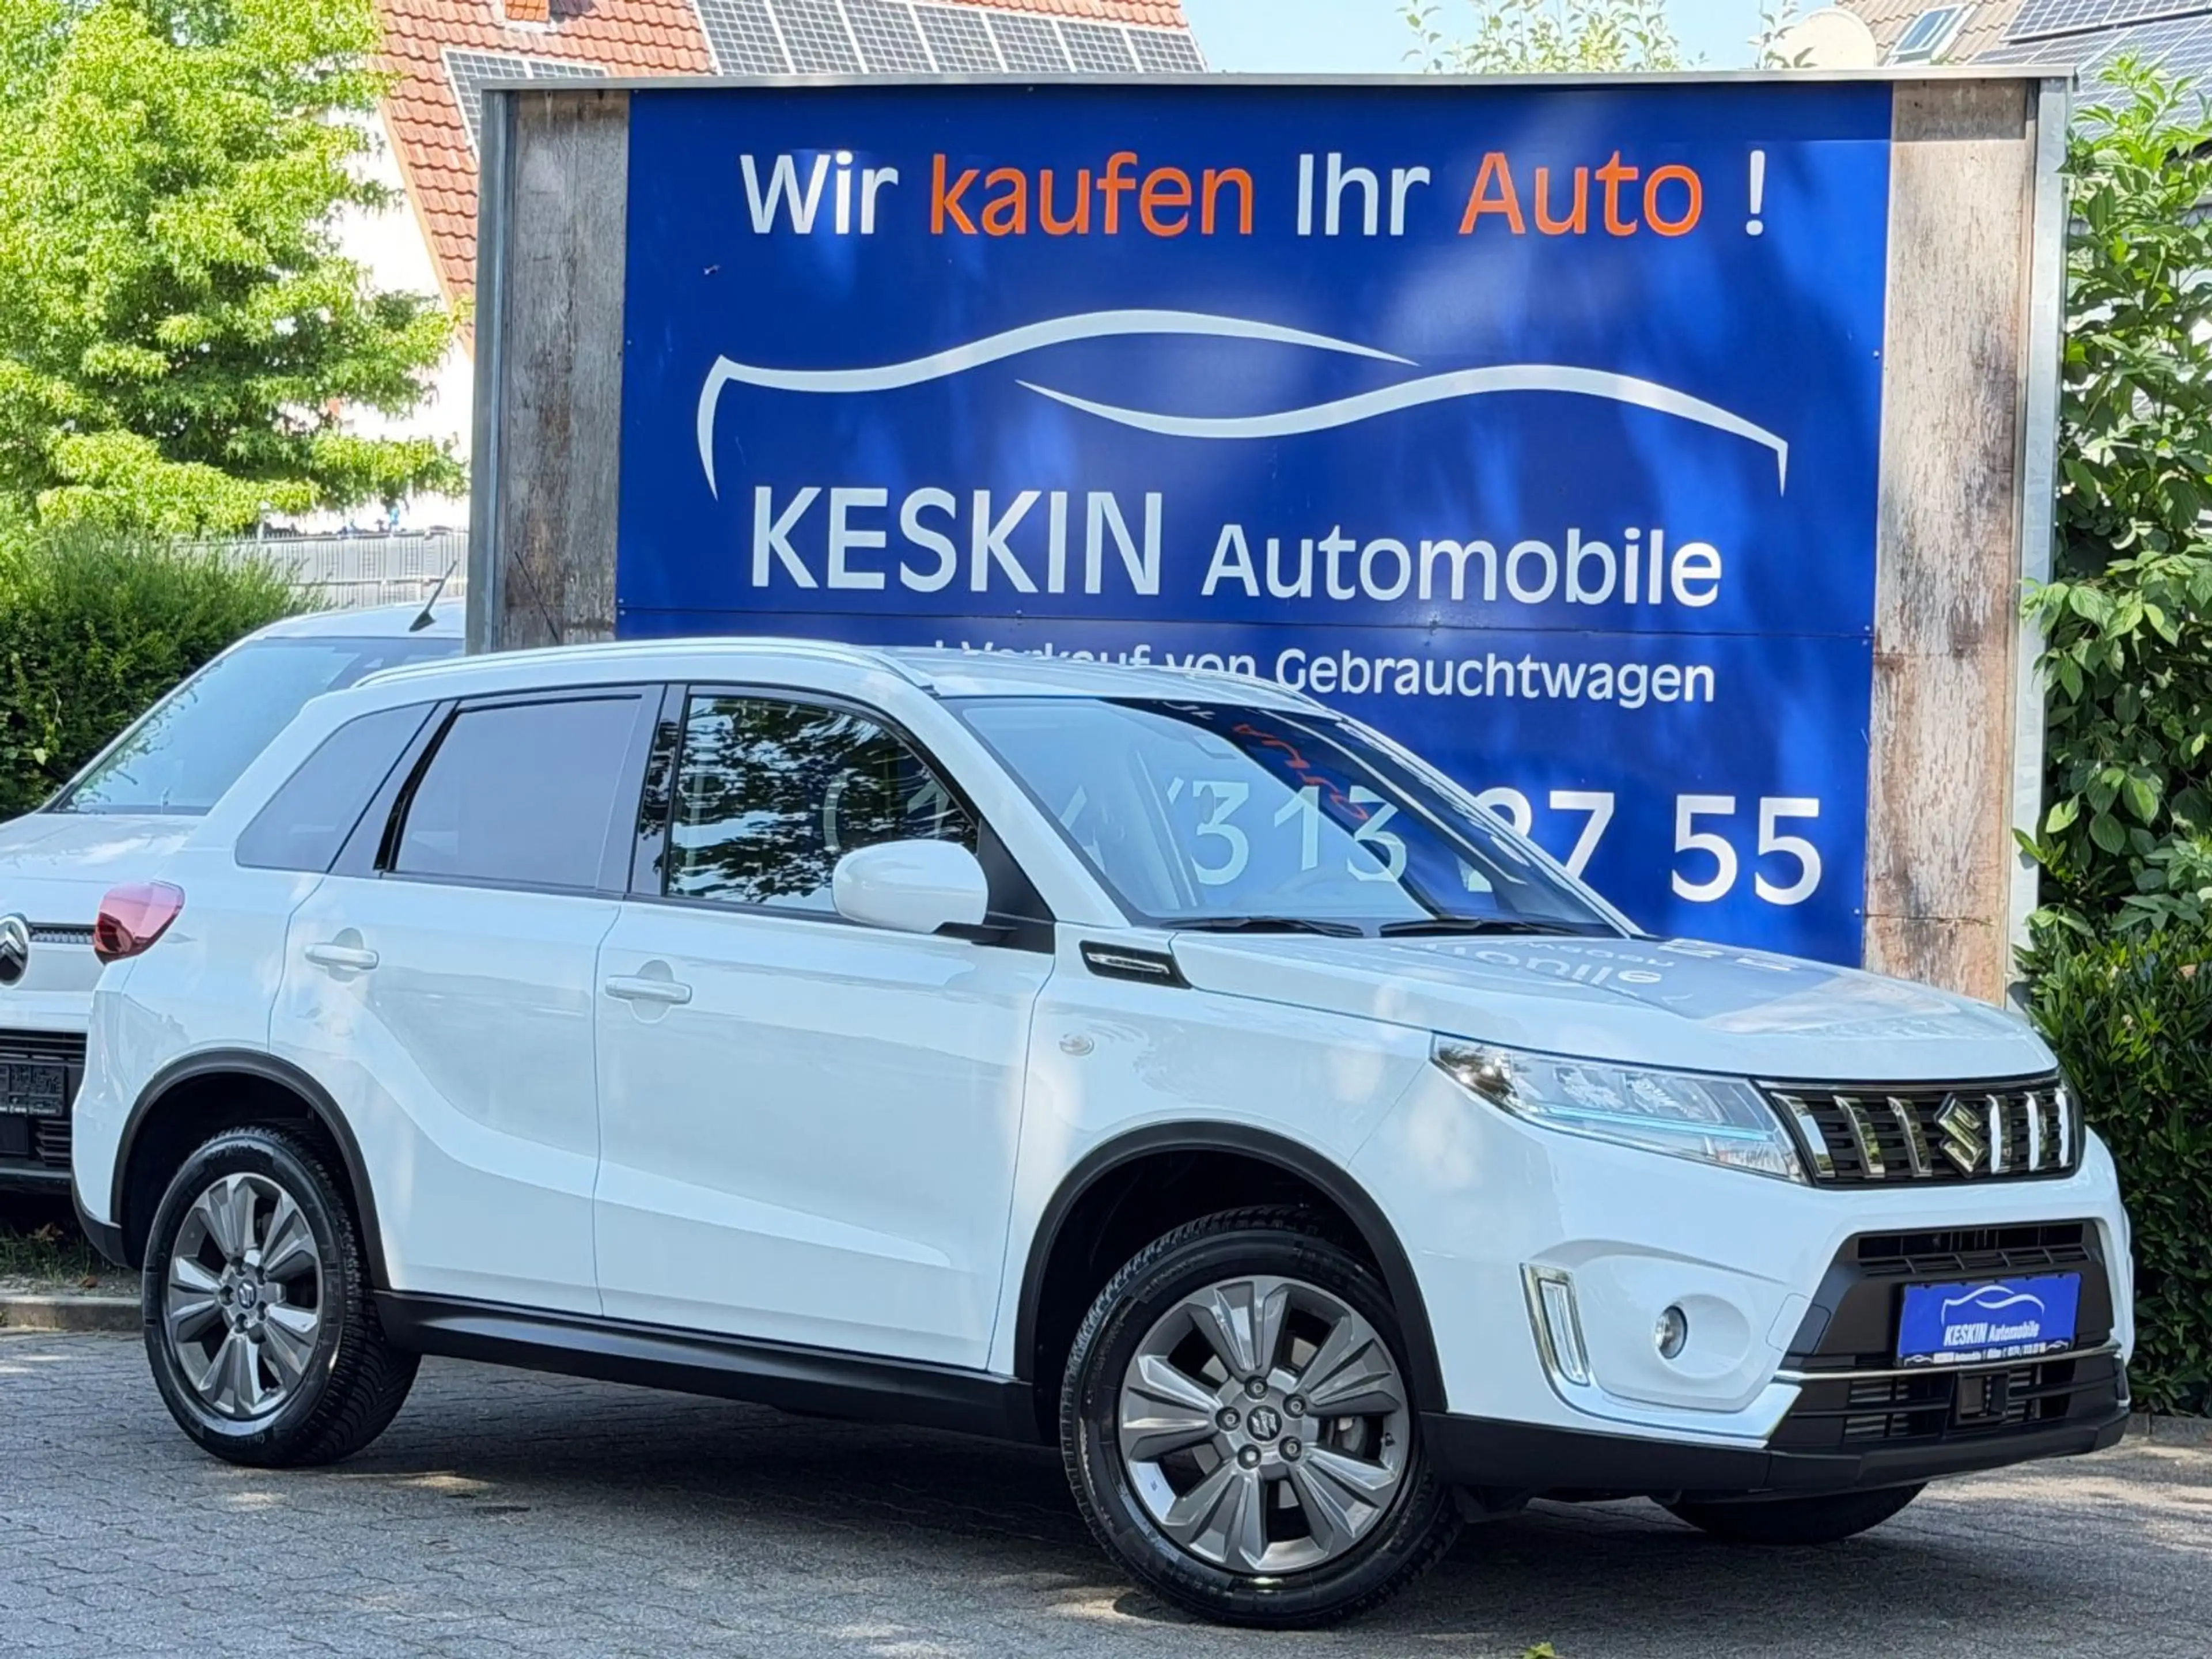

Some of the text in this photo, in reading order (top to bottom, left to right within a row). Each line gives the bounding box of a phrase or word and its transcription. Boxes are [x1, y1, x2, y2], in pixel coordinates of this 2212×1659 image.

[740, 150, 1766, 237] Wir kaufen Ihr Auto !
[751, 486, 1723, 608] KESKIN Automobile
[1275, 647, 1715, 709] Gebrauchtwagen
[1672, 794, 1823, 906] 55
[1944, 1320, 2040, 1346] KESKIN Automobile
